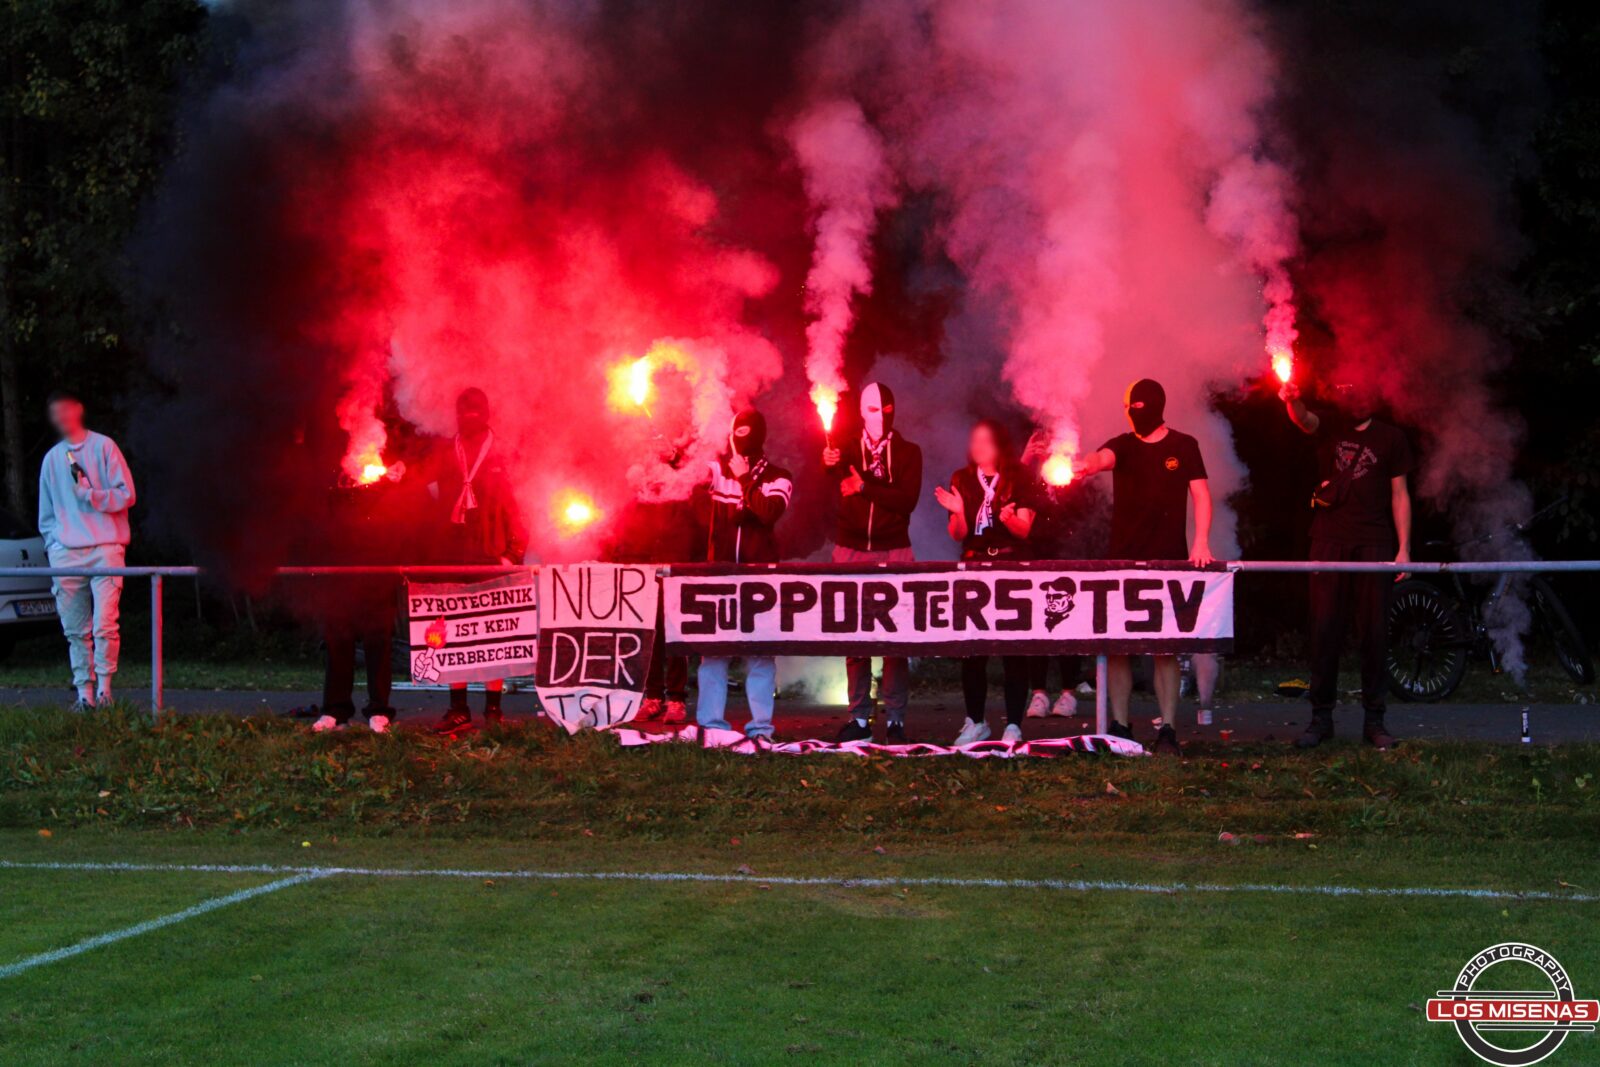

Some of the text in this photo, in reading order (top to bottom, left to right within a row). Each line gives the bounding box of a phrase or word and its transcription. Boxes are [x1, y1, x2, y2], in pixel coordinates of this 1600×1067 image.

[411, 587, 533, 613] PYROTECHNIK
[551, 567, 644, 623] NUR
[680, 578, 1207, 634] SUPPORTERS TSV
[455, 617, 520, 637] IST KEIN
[436, 645, 534, 666] VERBRECHEN
[549, 632, 641, 685] DER
